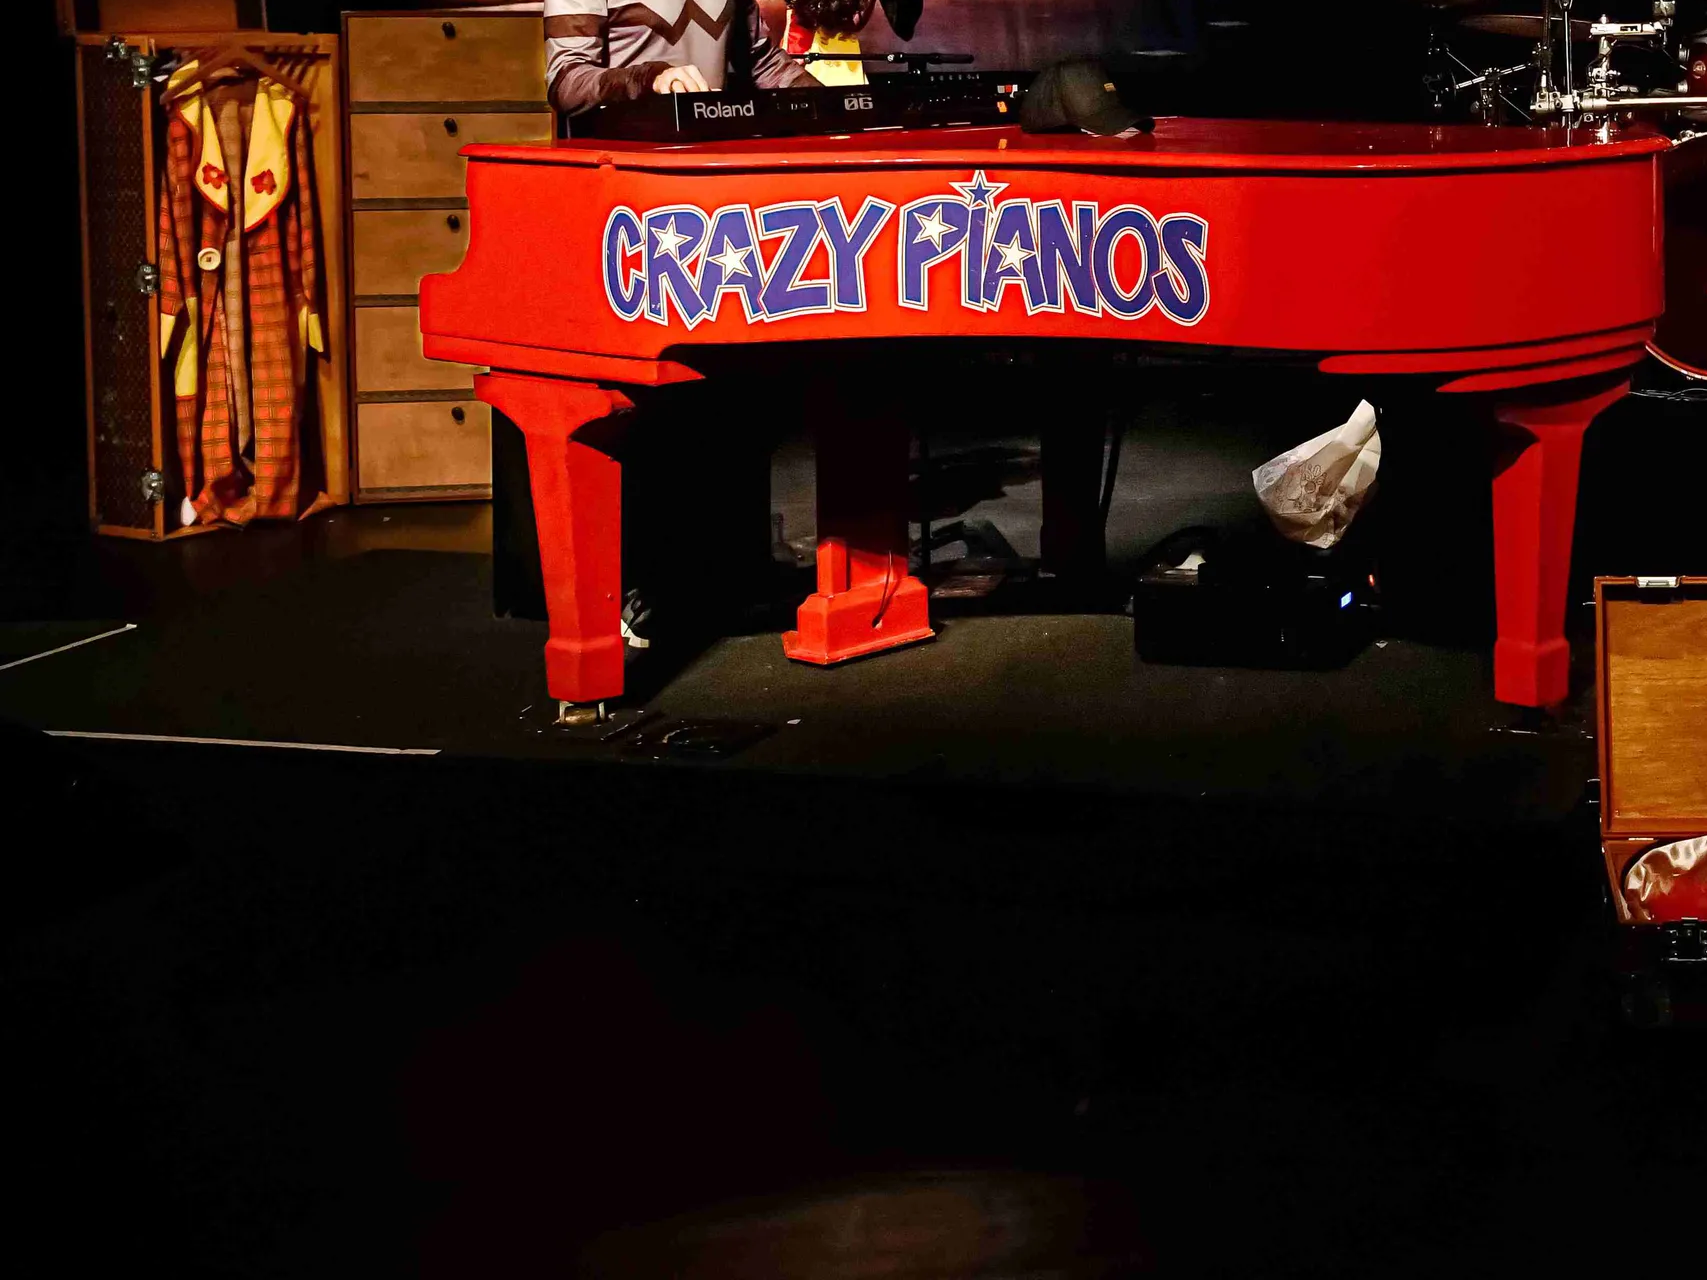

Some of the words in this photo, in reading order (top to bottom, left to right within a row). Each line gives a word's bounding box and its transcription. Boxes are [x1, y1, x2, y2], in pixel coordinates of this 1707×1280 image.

[693, 100, 755, 119] Roland
[602, 195, 896, 331] CRAZY
[898, 169, 1209, 327] PIANOS
